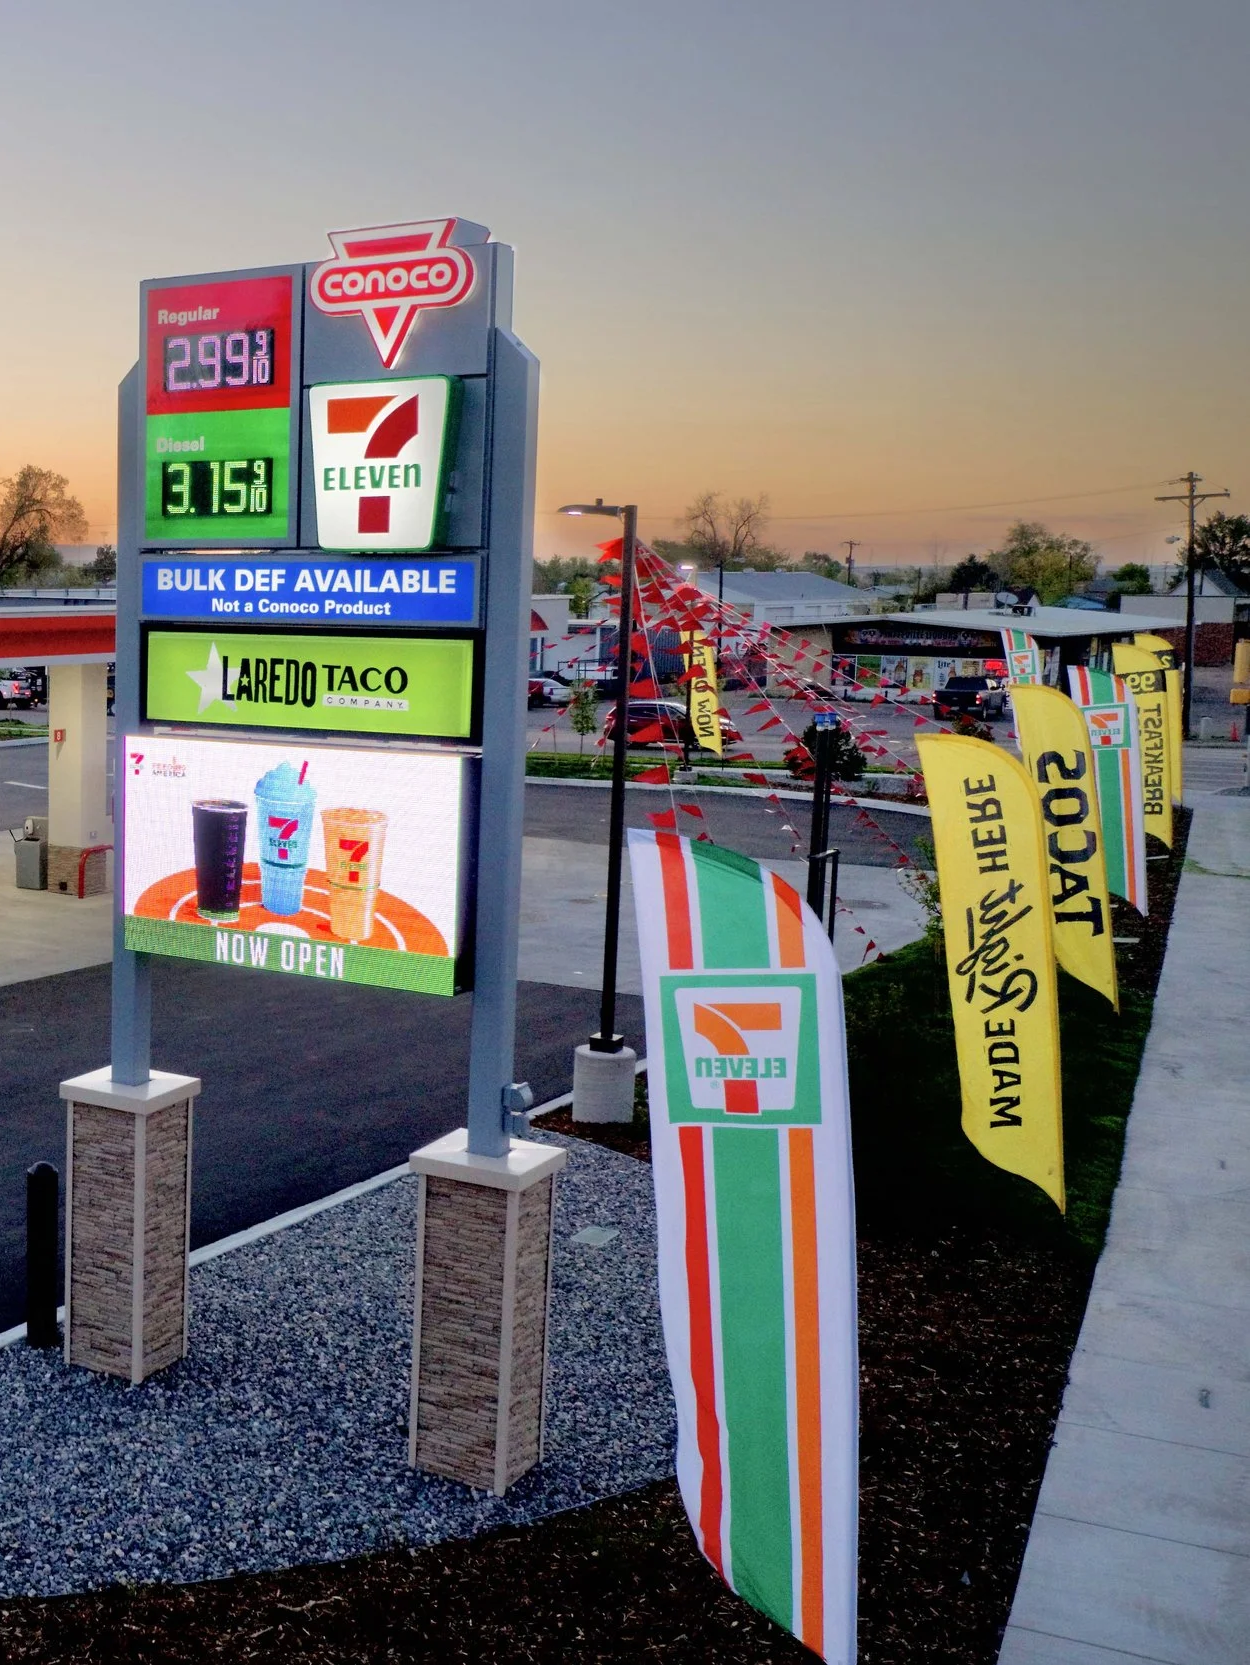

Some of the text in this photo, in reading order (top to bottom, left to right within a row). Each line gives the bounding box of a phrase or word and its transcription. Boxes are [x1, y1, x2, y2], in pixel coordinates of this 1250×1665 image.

[157, 306, 220, 326] Regular
[168, 332, 249, 391] 2.99
[156, 436, 205, 453] Diesel
[327, 394, 419, 534] 7
[167, 461, 247, 514] 3.15
[157, 568, 456, 593] BULK DEF AVAILABLE
[212, 598, 391, 615] Not a Conoco Product
[222, 656, 317, 708] LAREDO
[322, 664, 409, 694] TACO
[216, 931, 344, 979] NOW OPEN
